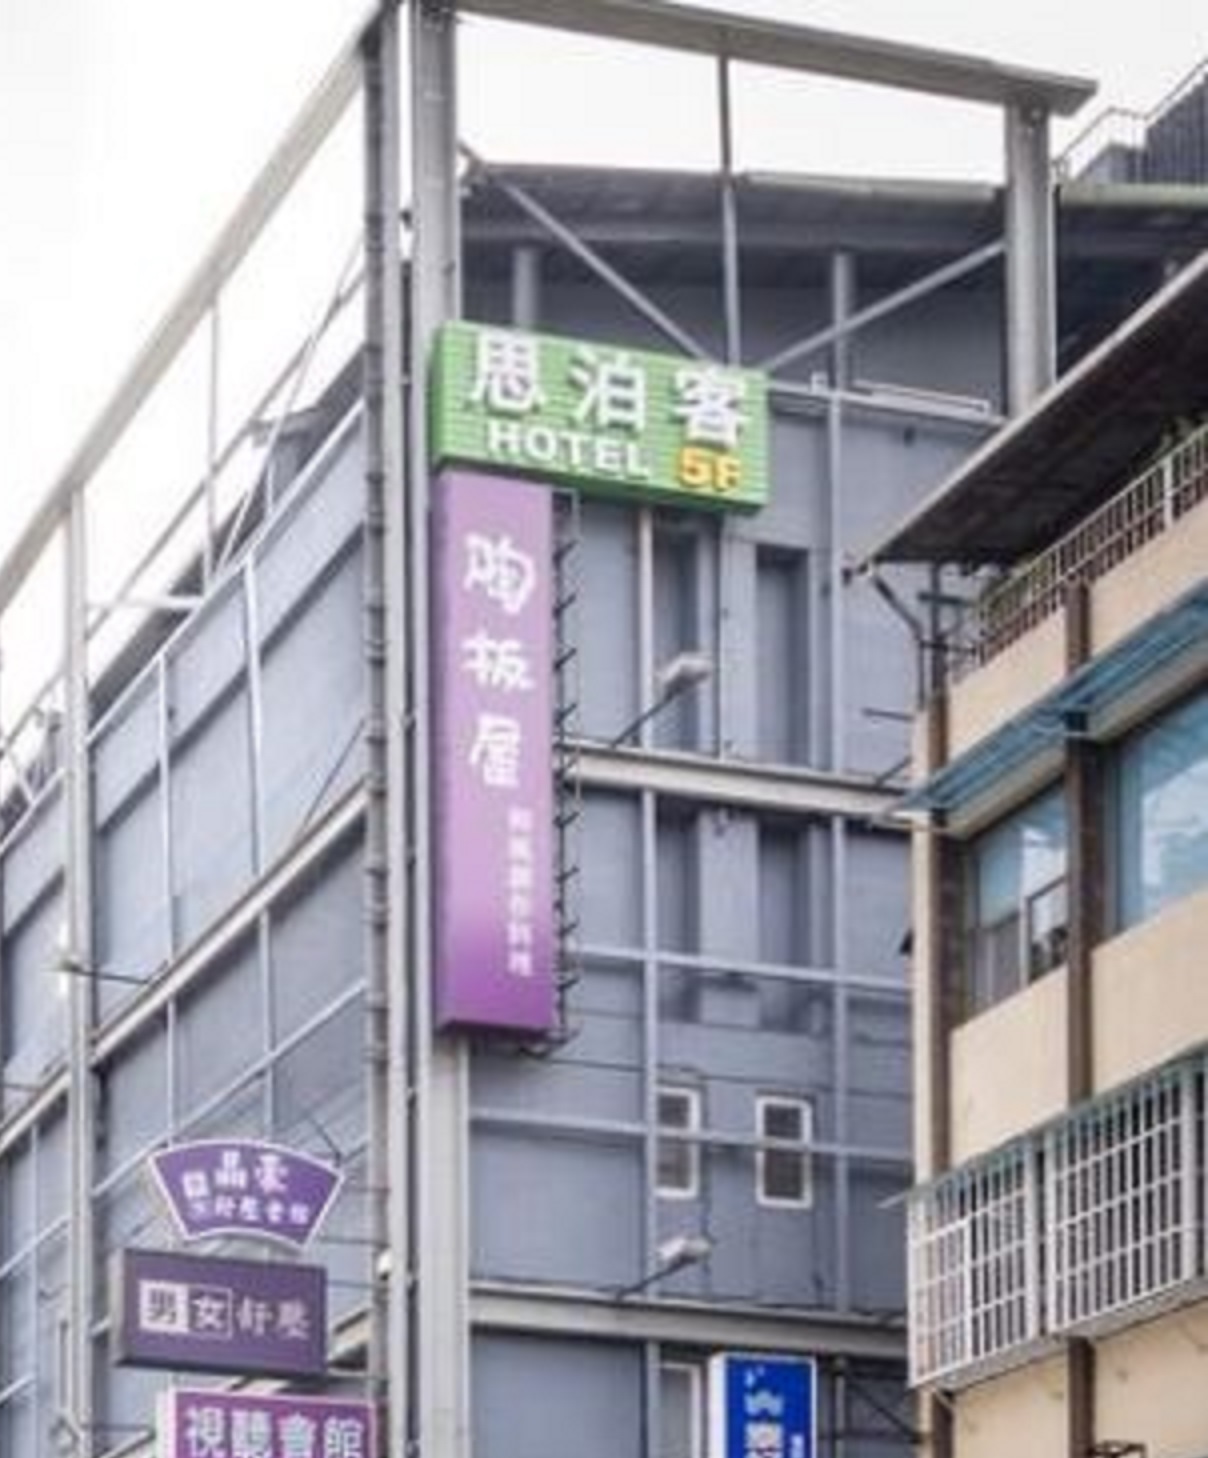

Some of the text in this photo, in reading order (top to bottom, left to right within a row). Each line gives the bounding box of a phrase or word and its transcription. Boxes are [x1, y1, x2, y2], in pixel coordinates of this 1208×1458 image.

[471, 329, 751, 447] 思泊客
[487, 418, 655, 482] HOTEL
